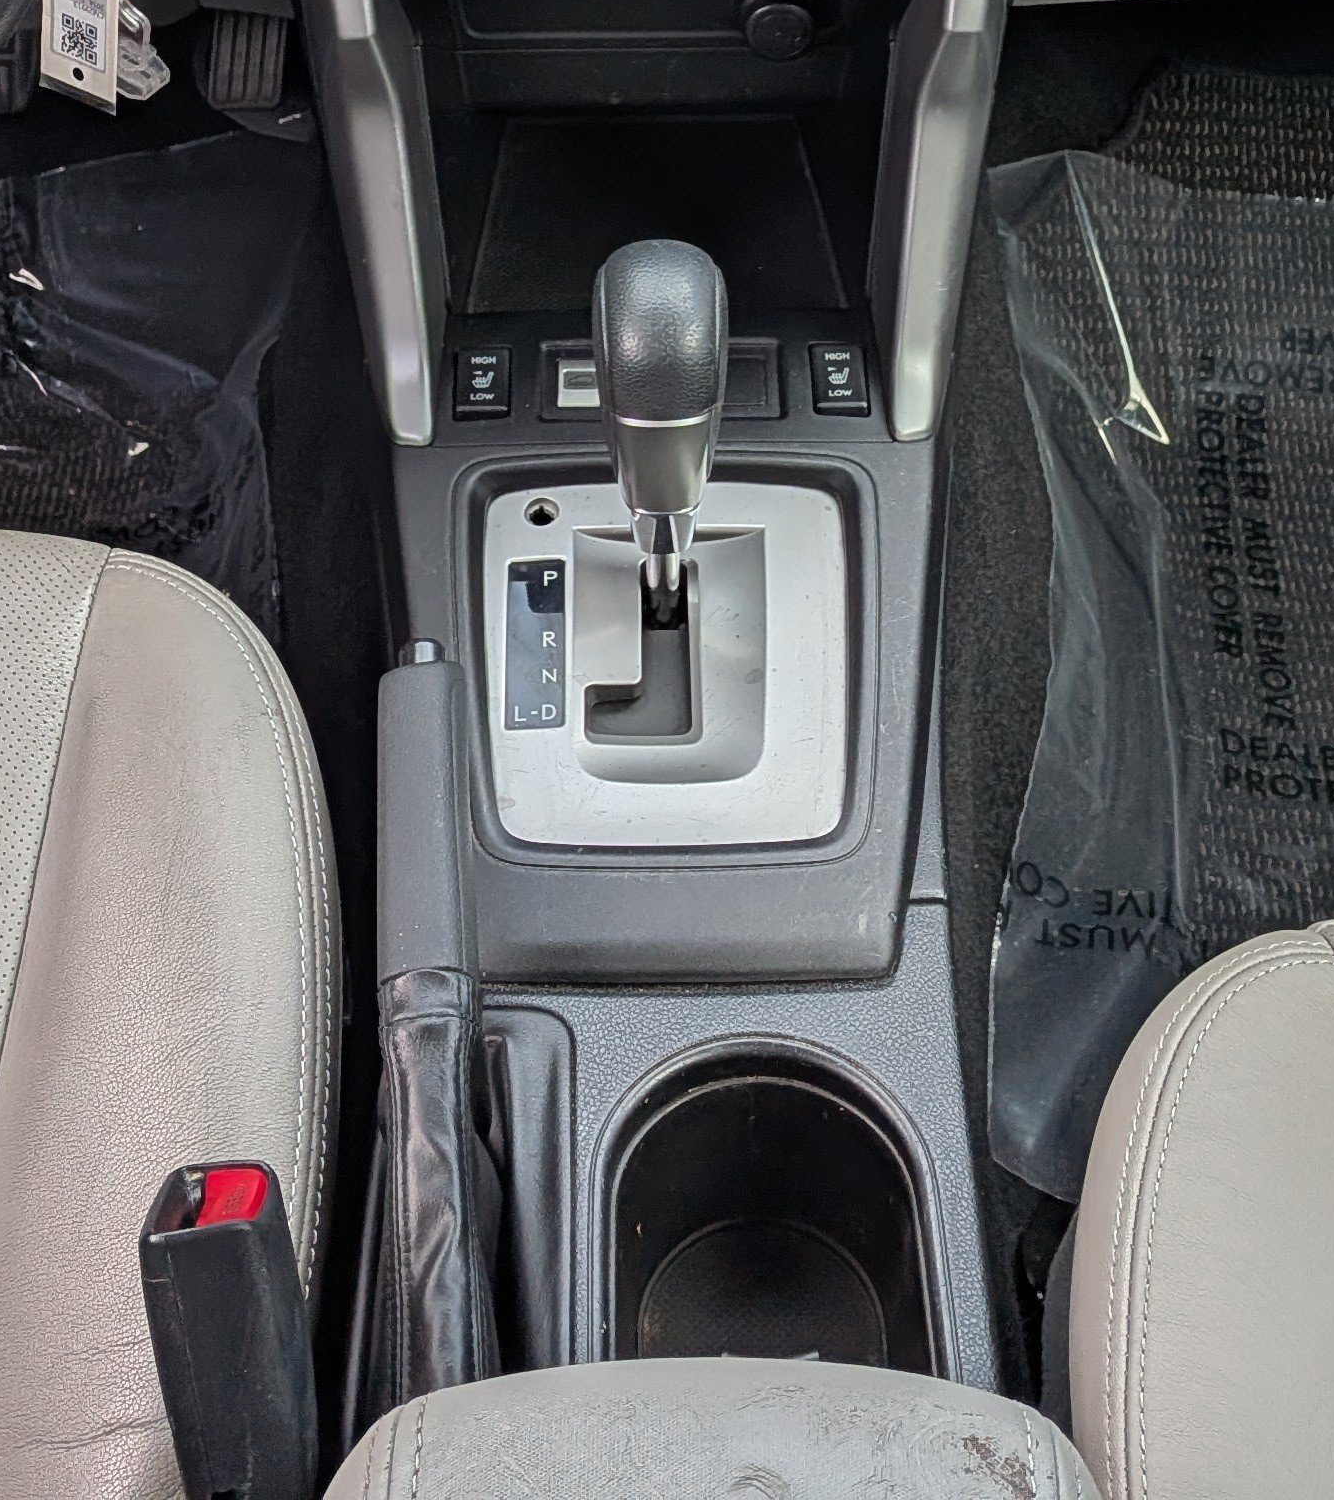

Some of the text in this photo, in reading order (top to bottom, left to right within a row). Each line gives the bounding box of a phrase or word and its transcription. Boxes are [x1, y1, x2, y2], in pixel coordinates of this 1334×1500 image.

[470, 355, 497, 365] HIGH
[824, 351, 850, 361] HIGH
[470, 392, 495, 401] LOW
[828, 389, 853, 398] LOW
[542, 571, 558, 587] P
[542, 631, 557, 647] R
[542, 669, 557, 684] N
[1034, 918, 1157, 959] MUST
